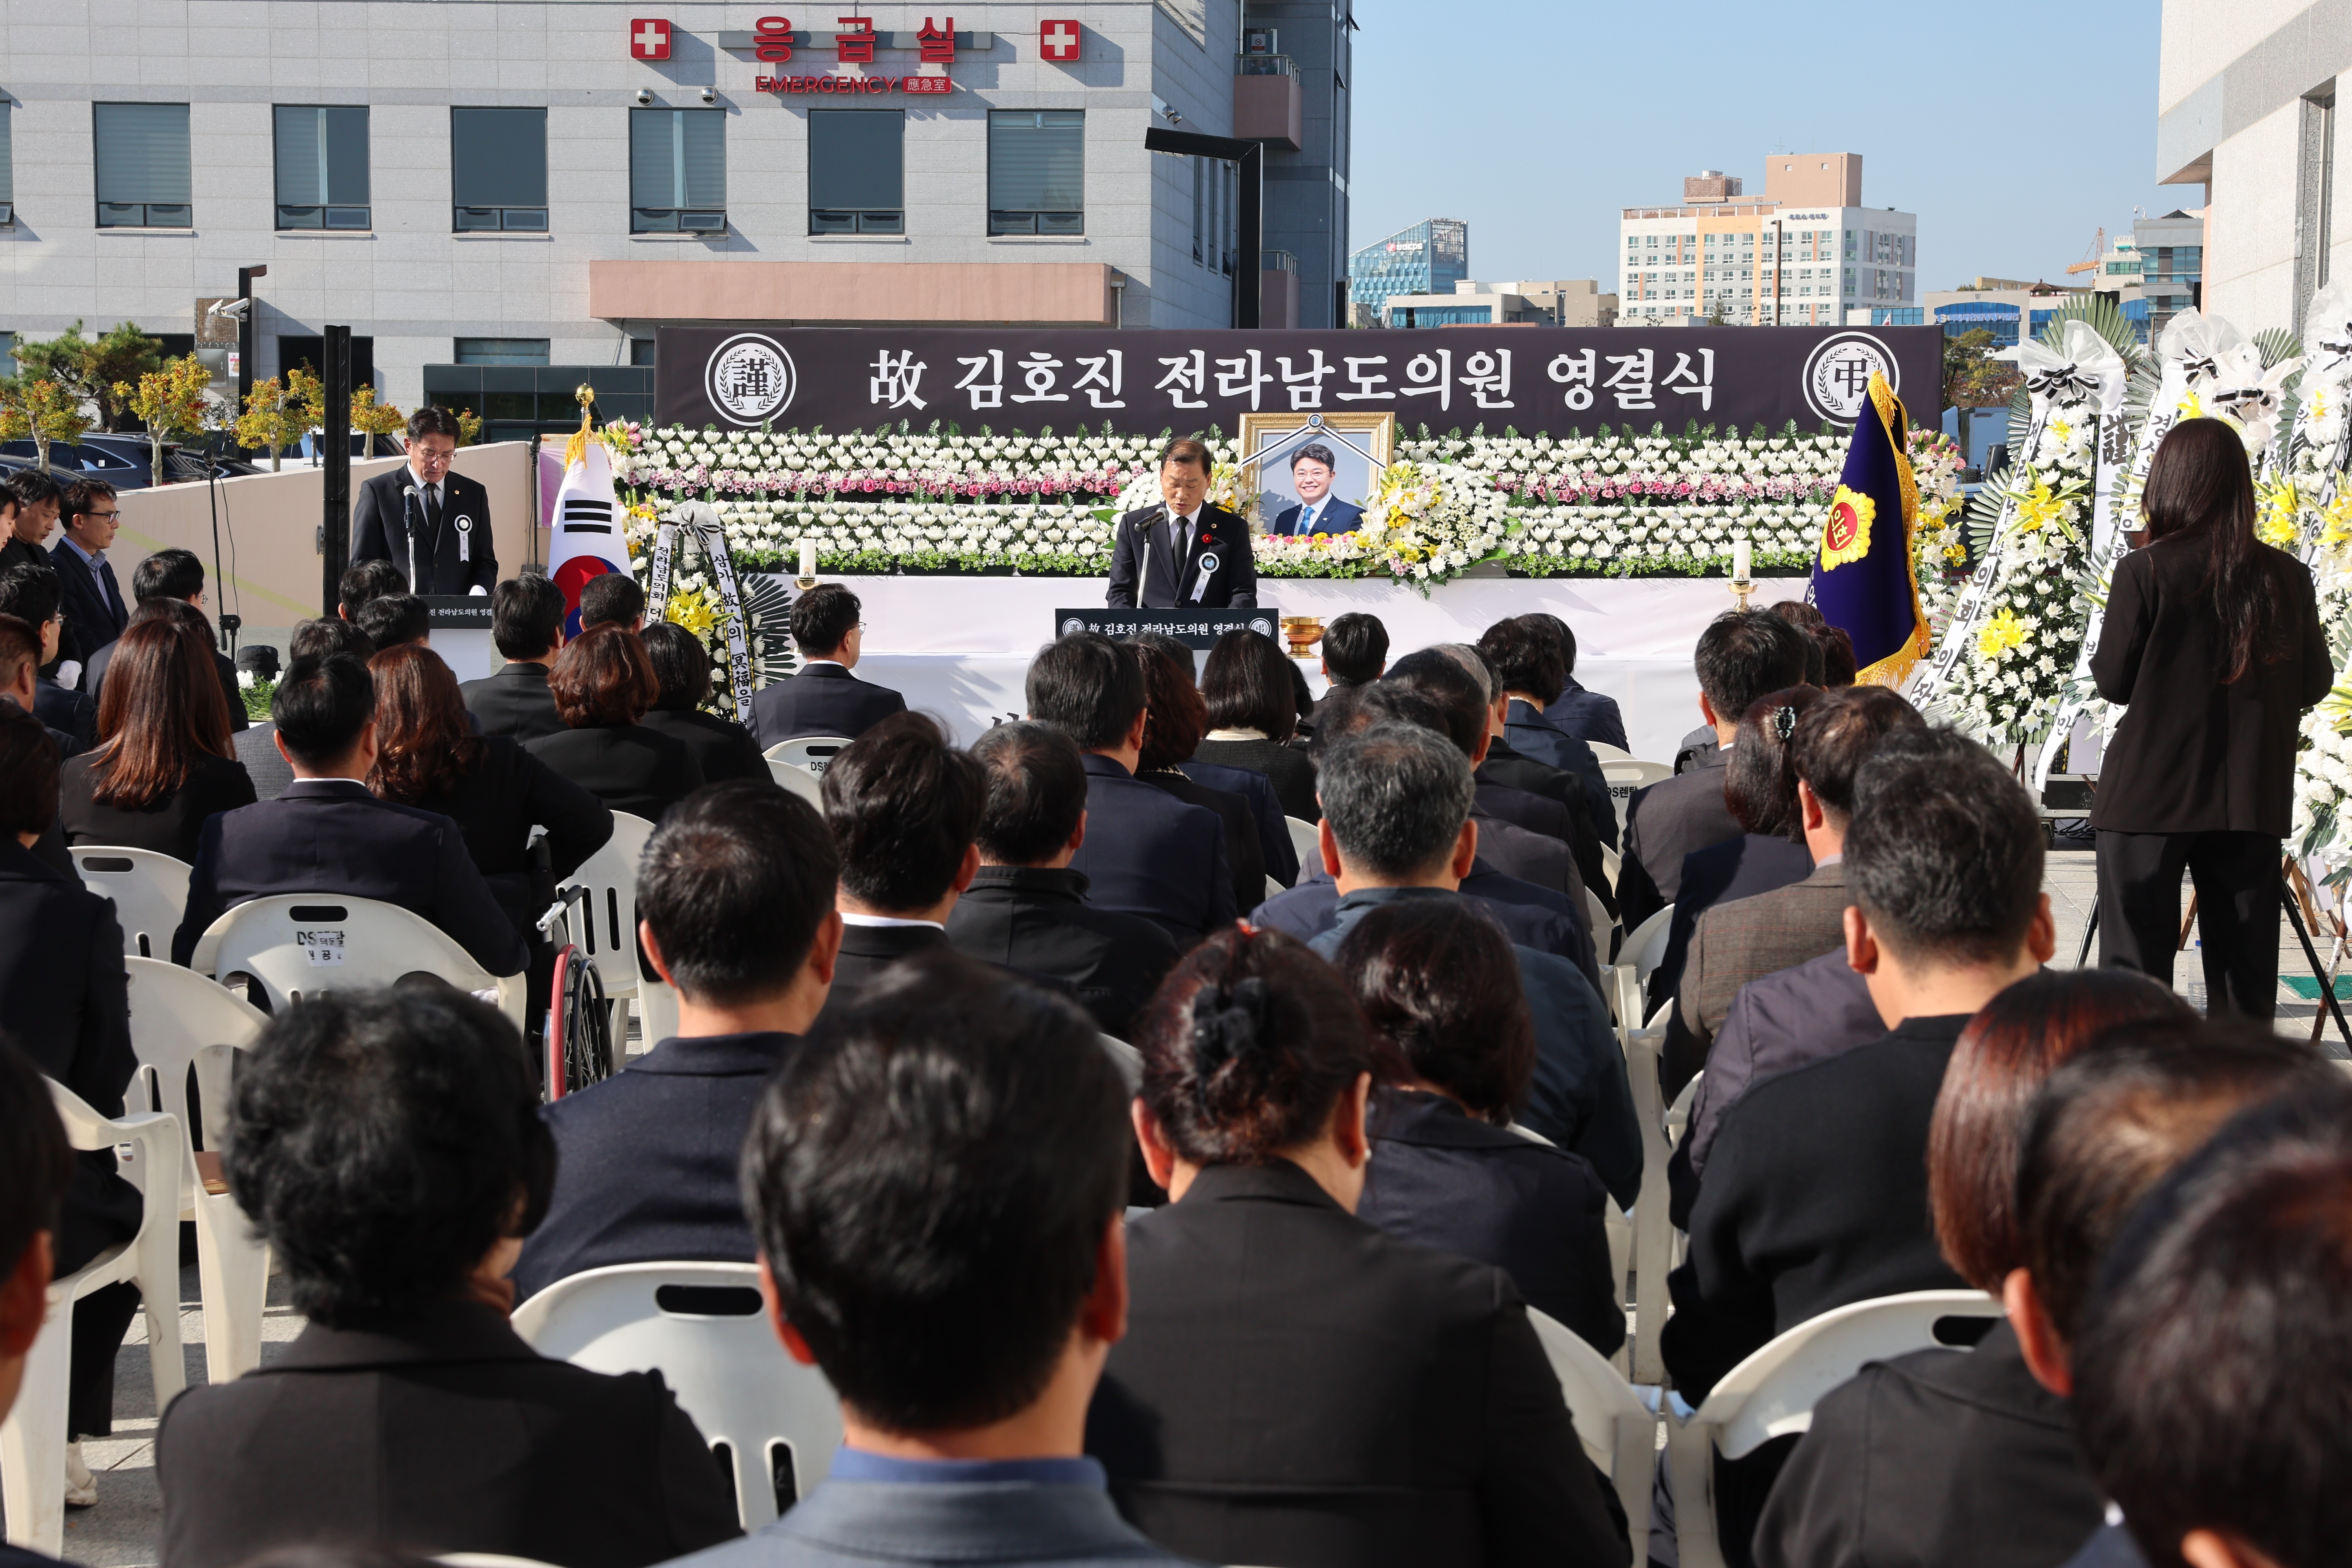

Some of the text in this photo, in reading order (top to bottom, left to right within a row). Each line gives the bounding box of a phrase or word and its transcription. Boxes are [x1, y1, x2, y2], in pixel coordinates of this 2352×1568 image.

[753, 16, 954, 62] 응급실
[755, 76, 946, 93] EMERGENCY 應急室
[732, 357, 770, 397] 謹
[870, 349, 1715, 412] 故 김호진 전라남도의원 영결식
[1835, 358, 1869, 398] 弔
[1831, 509, 1852, 548] 의회
[650, 546, 670, 602] 전라남도의회
[713, 554, 734, 583] 삼가
[722, 592, 743, 642] 故人의
[1104, 623, 1136, 635] 김호진
[1141, 623, 1209, 635] 전라남도의원
[731, 652, 751, 706] 冥福을
